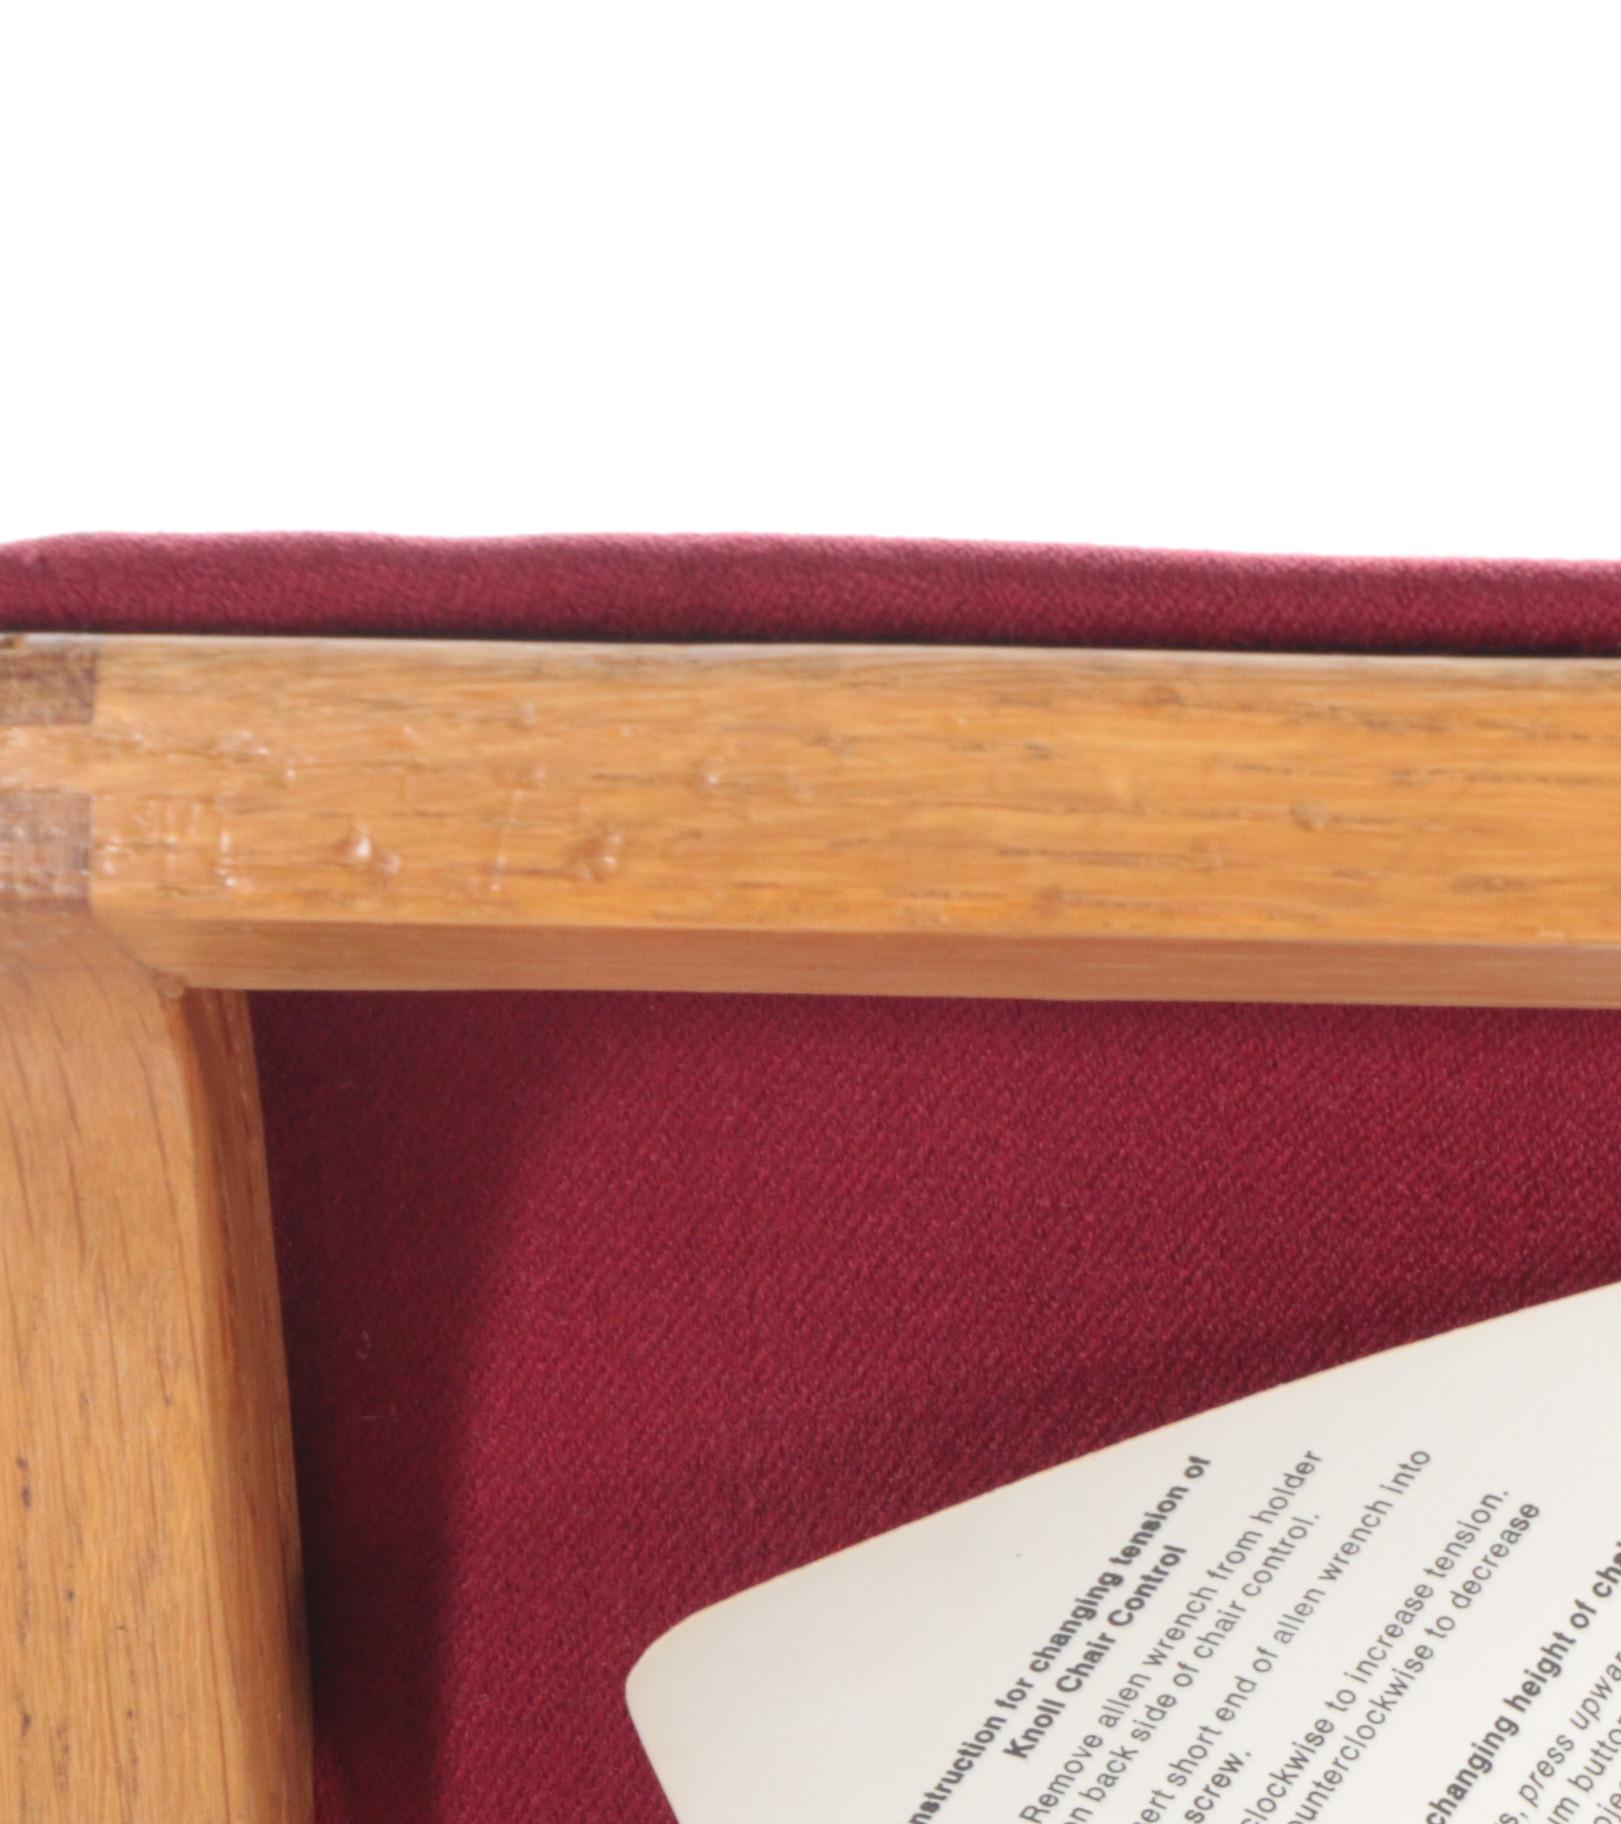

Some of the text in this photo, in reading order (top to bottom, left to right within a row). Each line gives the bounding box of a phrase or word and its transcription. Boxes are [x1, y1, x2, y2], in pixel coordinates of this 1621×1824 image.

[993, 1676, 1034, 1710] for
[1028, 1570, 1125, 1673] changing
[1107, 1485, 1190, 1566] tension
[1182, 1454, 1211, 1480] of
[1001, 1543, 1187, 1760] Knoll Chair Control
[1017, 1733, 1104, 1824] Remove
[1097, 1672, 1151, 1729] allen
[1141, 1585, 1218, 1666] wrench
[1205, 1529, 1263, 1580] from
[1249, 1449, 1321, 1524] holder
[1077, 1744, 1139, 1803] back
[1129, 1693, 1177, 1742] side
[1171, 1660, 1199, 1688] of
[1192, 1599, 1246, 1659] chair
[1240, 1514, 1319, 1597] control.
[1165, 1724, 1222, 1787] short
[1214, 1674, 1257, 1722] end
[1251, 1645, 1278, 1673] of
[1272, 1587, 1325, 1644] allen
[1317, 1499, 1393, 1581] wrench
[1379, 1449, 1431, 1495] into
[1323, 1688, 1357, 1712] to
[1342, 1583, 1434, 1684] increase
[1422, 1490, 1509, 1578] tension.
[1423, 1614, 1456, 1639] to
[1449, 1502, 1540, 1609] decrease
[1502, 1630, 1577, 1713] height
[1568, 1597, 1597, 1630] of
[1183, 1751, 1251, 1824] screw.
[1517, 1733, 1575, 1809] press
